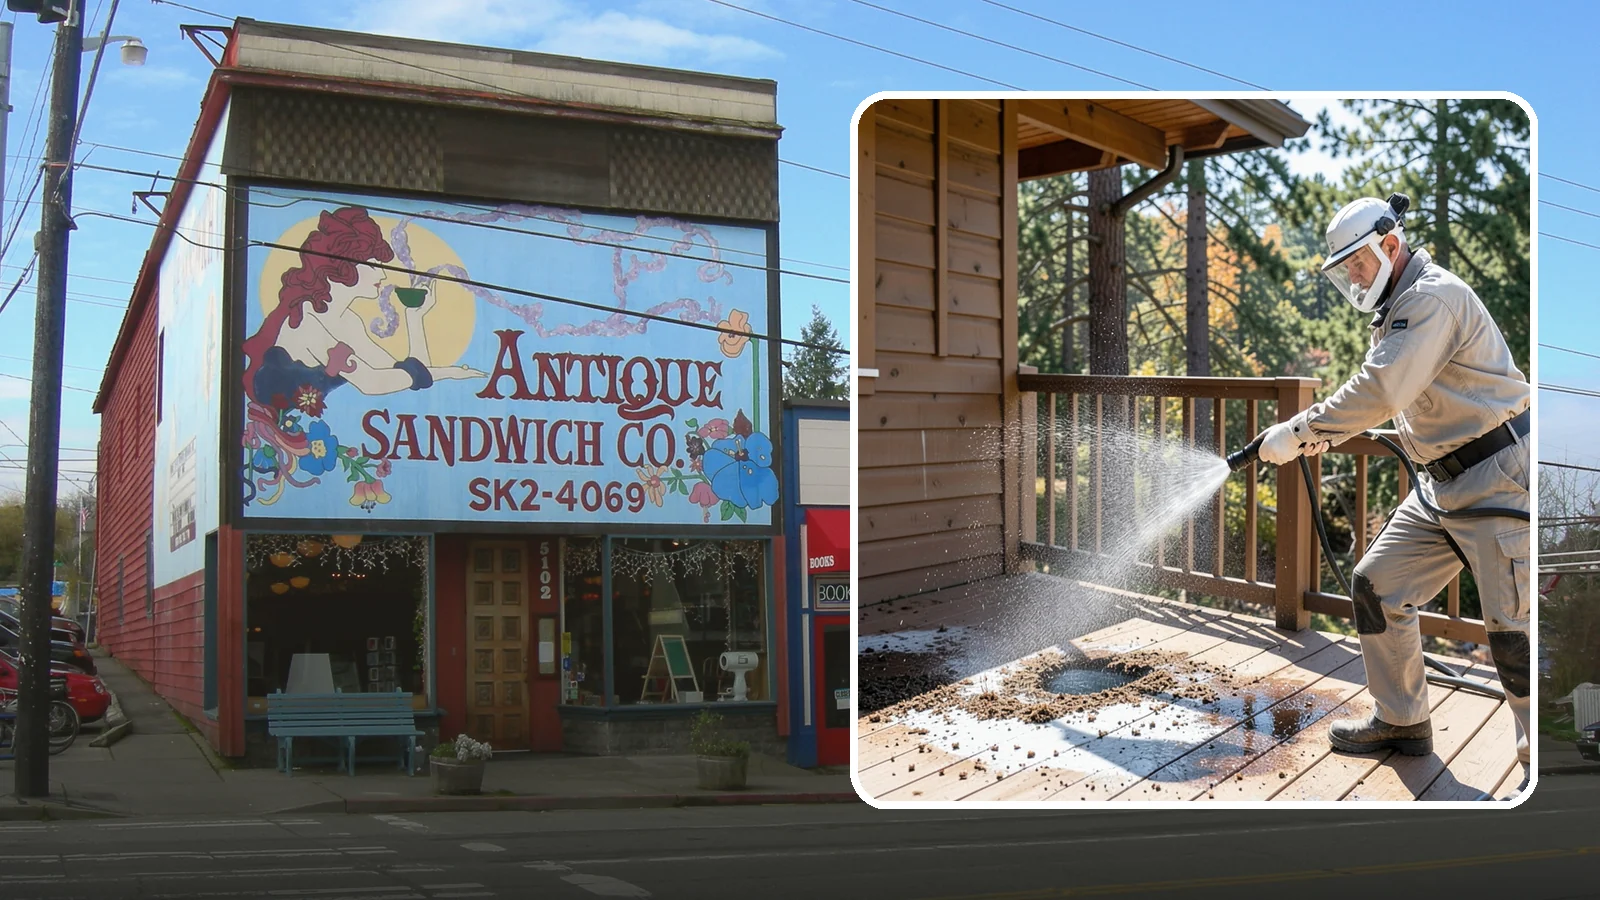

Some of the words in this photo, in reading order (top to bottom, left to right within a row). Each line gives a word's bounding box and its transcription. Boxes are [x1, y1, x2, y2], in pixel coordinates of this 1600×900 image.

[476, 330, 723, 420] ANTIQUE
[361, 408, 604, 467] SANDWICH
[617, 421, 684, 469] CO.
[468, 477, 645, 512] SK2-4069
[541, 542, 551, 599] 5102
[809, 555, 835, 569] BOOKS
